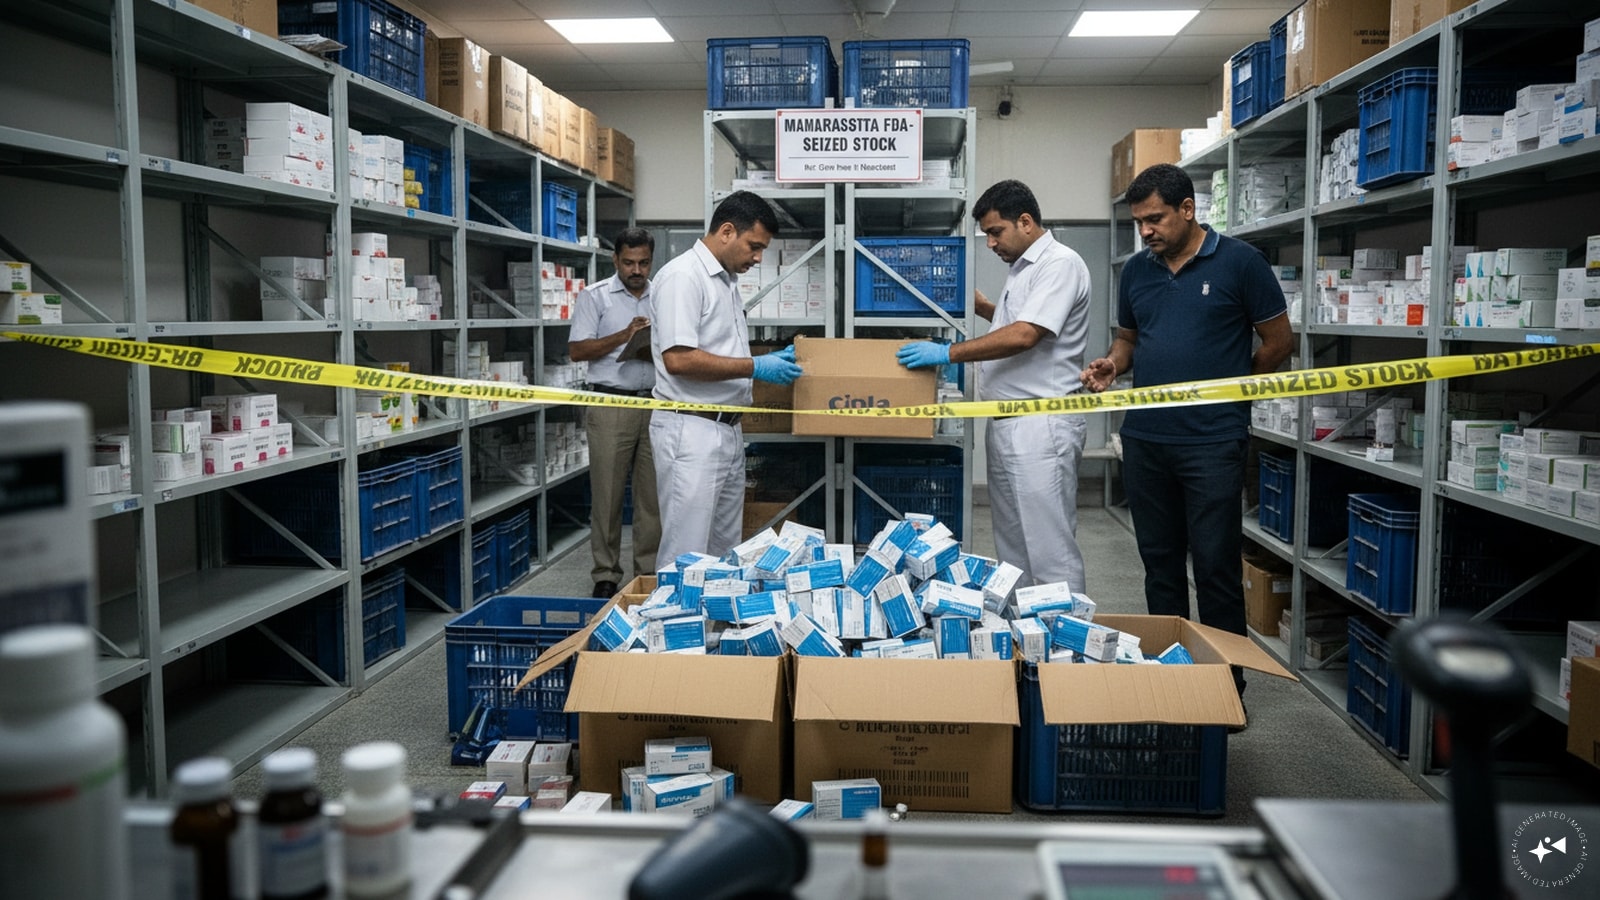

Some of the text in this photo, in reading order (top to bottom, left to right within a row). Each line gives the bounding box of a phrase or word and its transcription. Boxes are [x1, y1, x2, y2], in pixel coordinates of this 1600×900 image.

[784, 118, 914, 132] MAMARASSTTA FDA-
[803, 137, 897, 151] SEIZED STOCK
[1240, 361, 1434, 396] DAIZED STOCK
